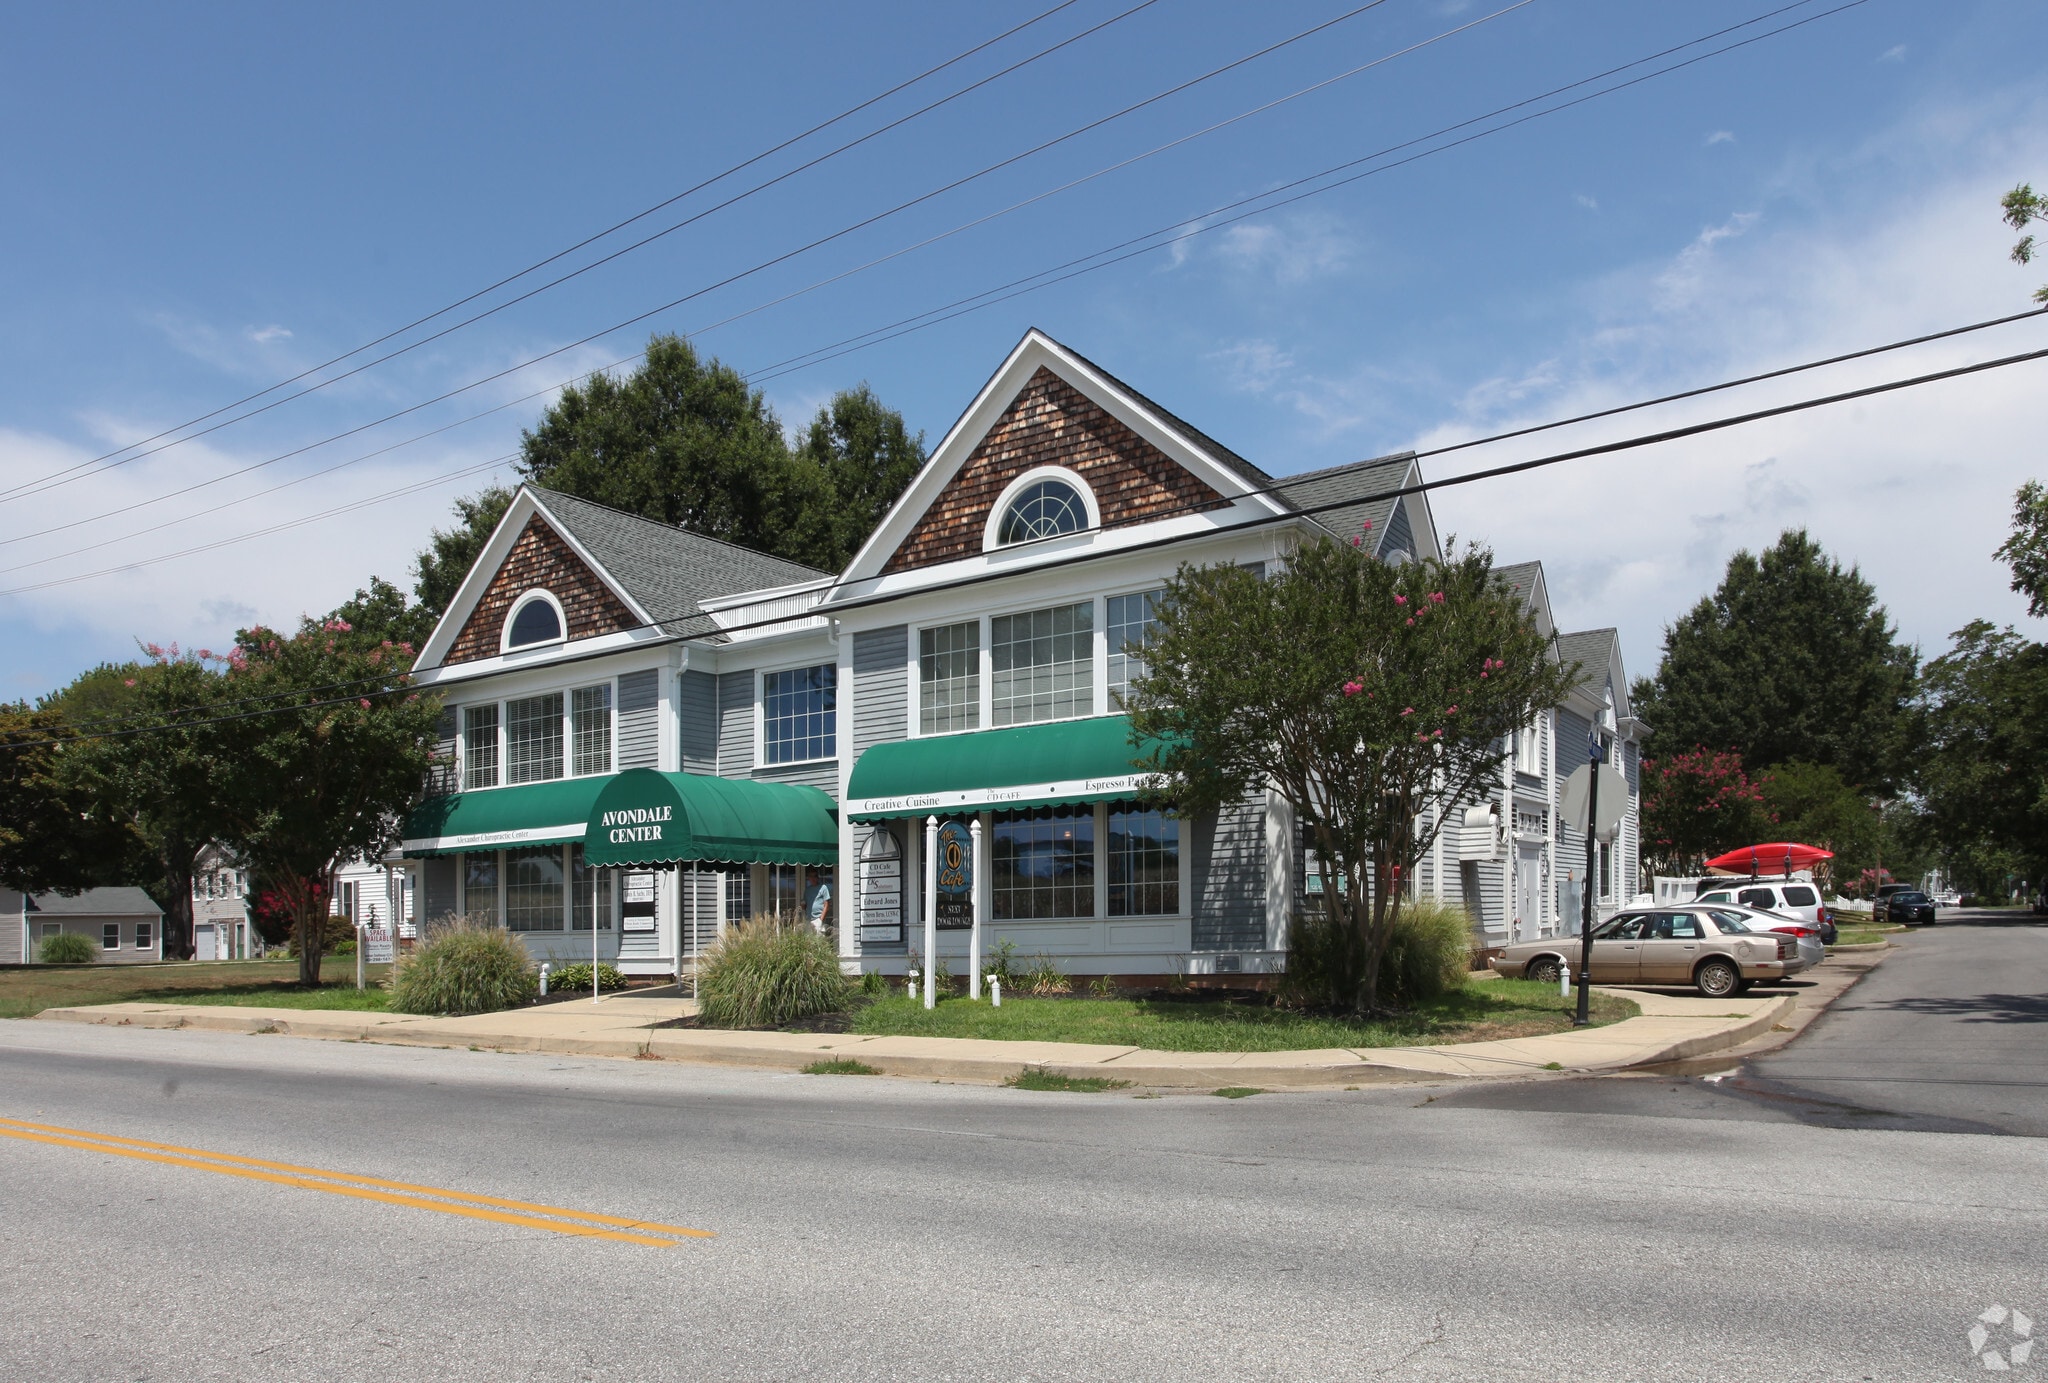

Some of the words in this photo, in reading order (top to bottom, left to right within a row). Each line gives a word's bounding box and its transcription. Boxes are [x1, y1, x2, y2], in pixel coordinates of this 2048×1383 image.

[1085, 779, 1125, 792] Espresso
[864, 800, 902, 811] Creative
[906, 796, 940, 808] Cuisine
[987, 793, 999, 802] CD
[1000, 792, 1021, 801] CAFE
[601, 806, 672, 826] AVONDALE
[457, 835, 480, 843] Alexander
[481, 832, 511, 841] Chiropractic
[512, 831, 529, 839] Center
[609, 825, 662, 843] CENTER
[941, 829, 957, 845] The
[940, 869, 964, 890] Cafe
[884, 897, 897, 905] Jones
[947, 904, 961, 914] NEXT
[937, 917, 952, 926] DOOR
